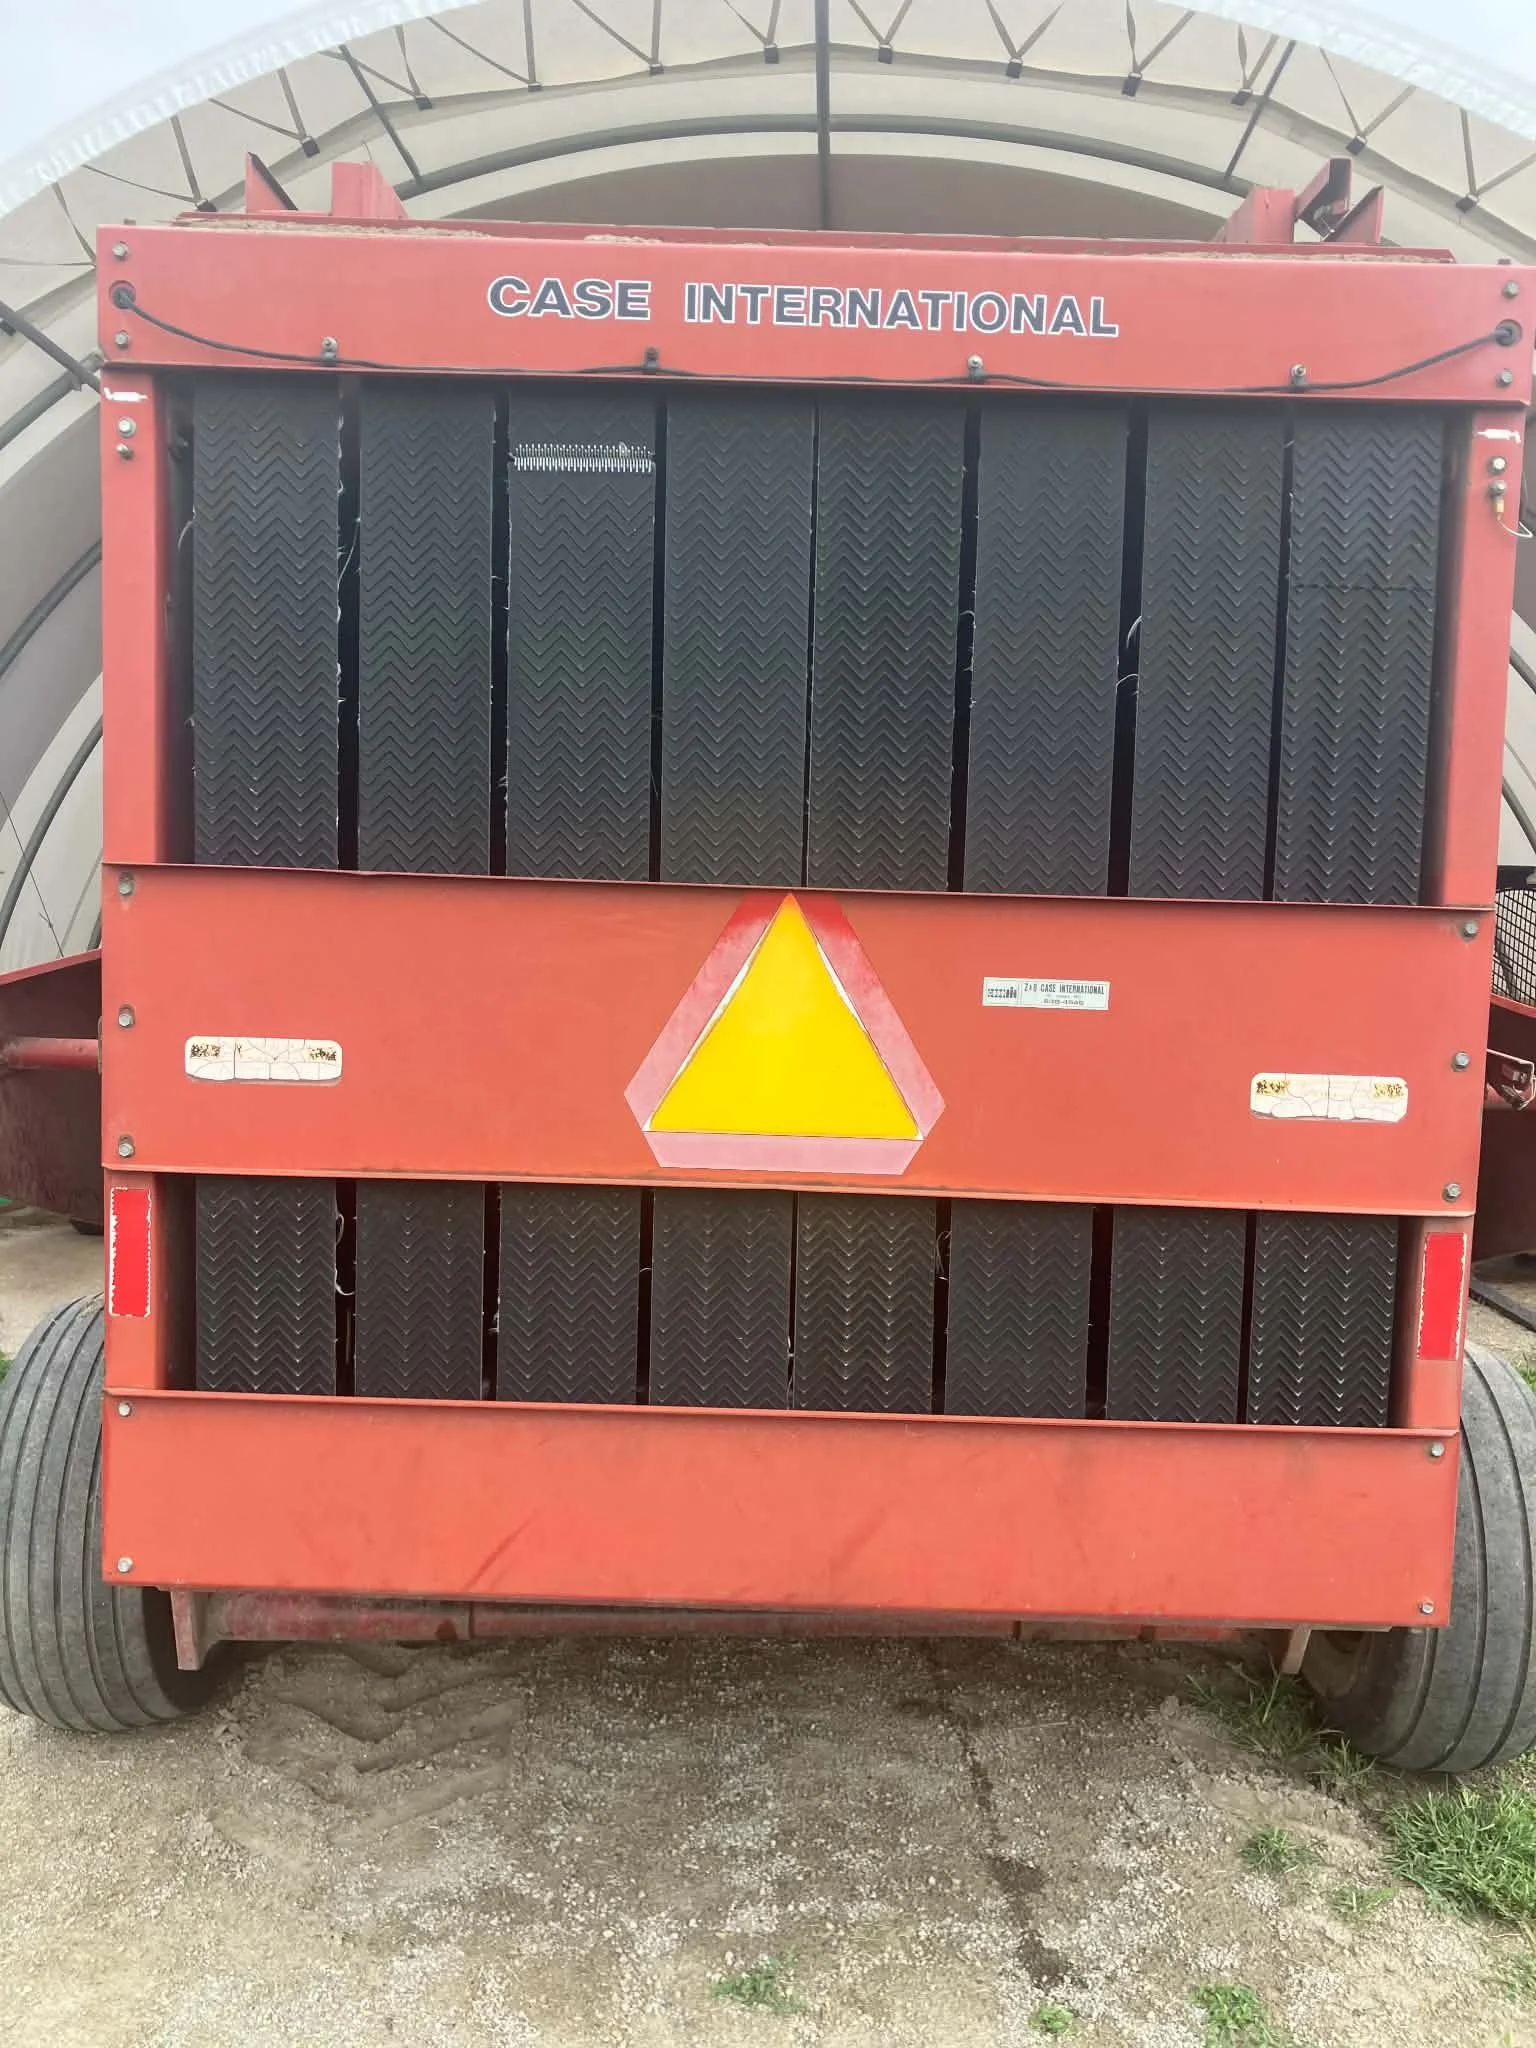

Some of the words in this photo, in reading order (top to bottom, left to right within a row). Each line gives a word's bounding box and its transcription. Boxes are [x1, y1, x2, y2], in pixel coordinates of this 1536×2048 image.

[487, 275, 651, 321] CASE
[684, 283, 1120, 338] INTERNATIONAL
[1040, 983, 1056, 993] CASE
[1060, 984, 1105, 995] INTERNATIONAL
